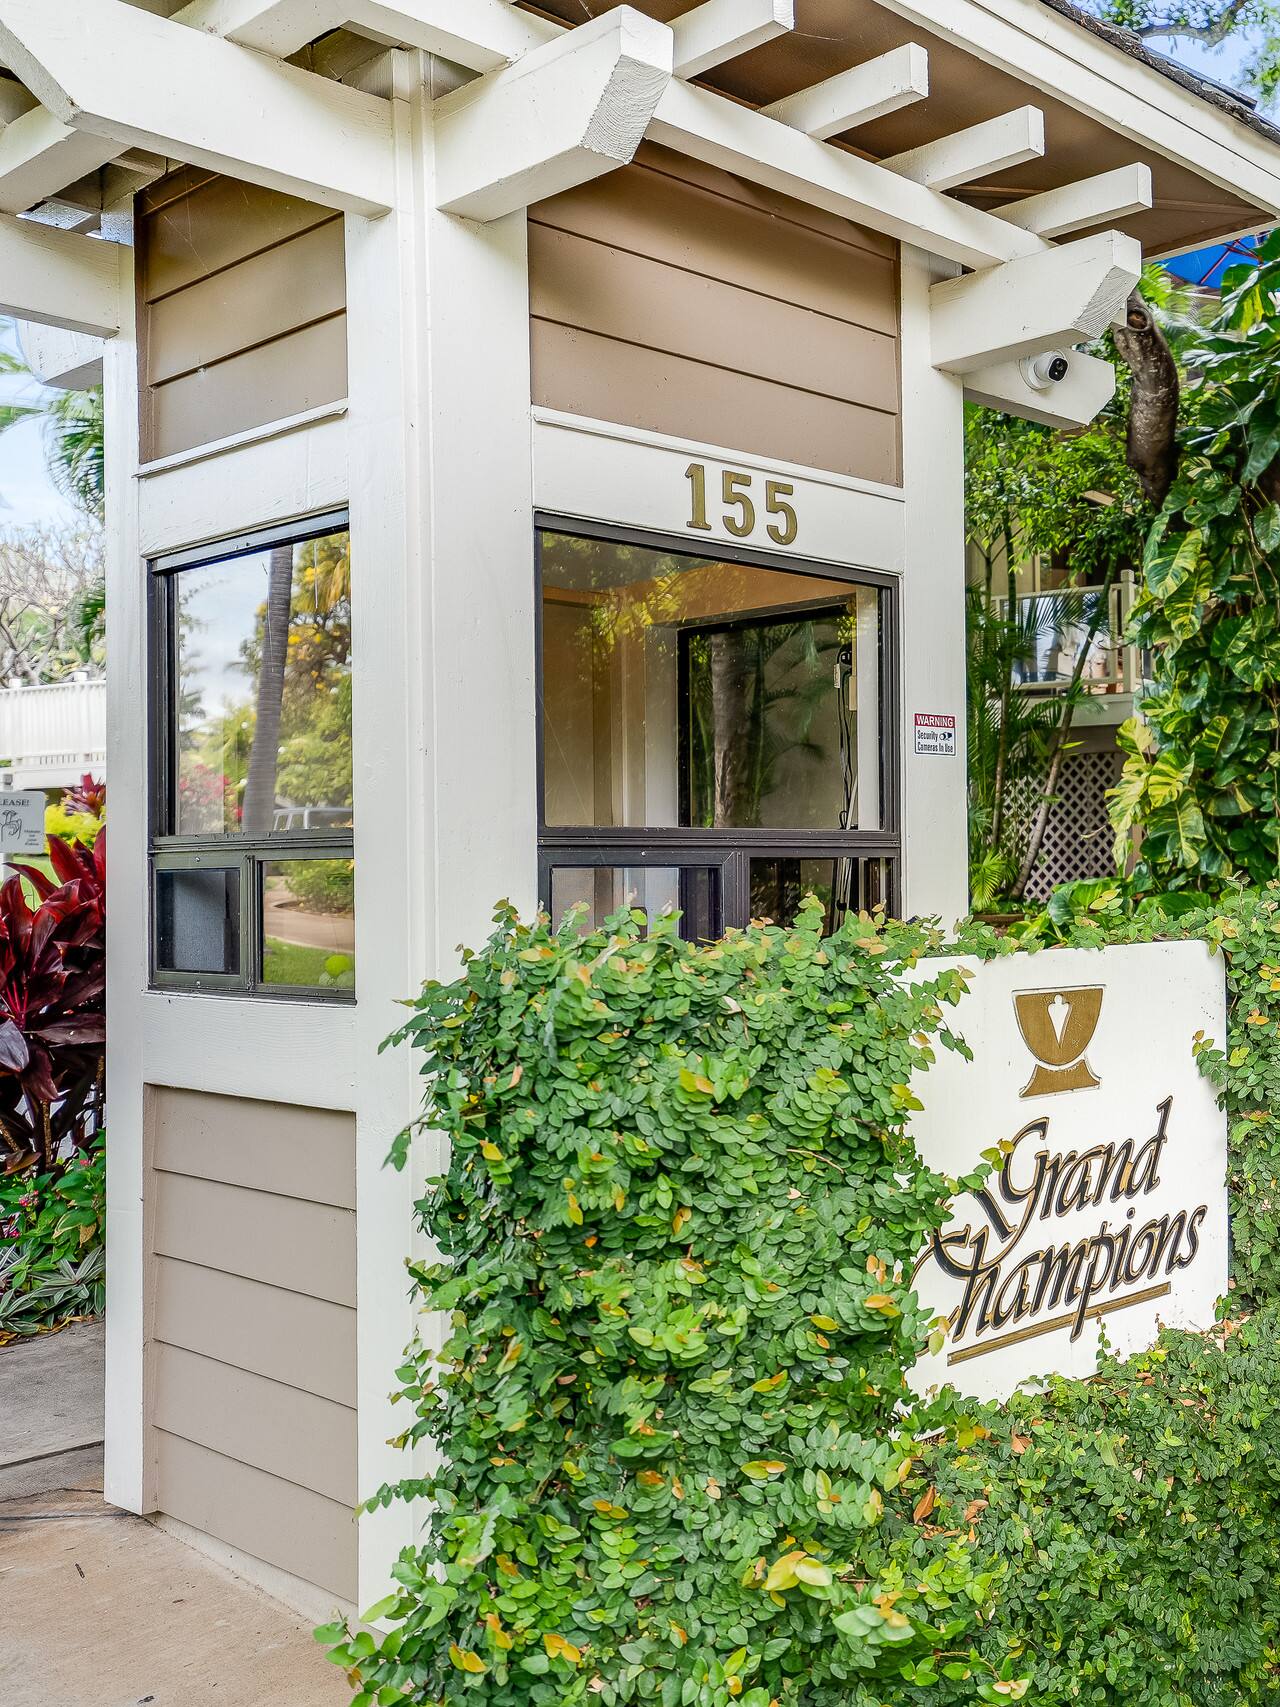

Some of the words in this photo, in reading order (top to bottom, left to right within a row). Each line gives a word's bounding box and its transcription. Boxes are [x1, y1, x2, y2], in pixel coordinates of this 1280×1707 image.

[685, 463, 798, 545] 155
[916, 714, 954, 727] WARNING
[917, 730, 938, 742] Security
[917, 742, 938, 752] Cameras
[945, 743, 954, 753] Use
[0, 798, 29, 806] EASE!
[995, 1095, 1174, 1232] Grand
